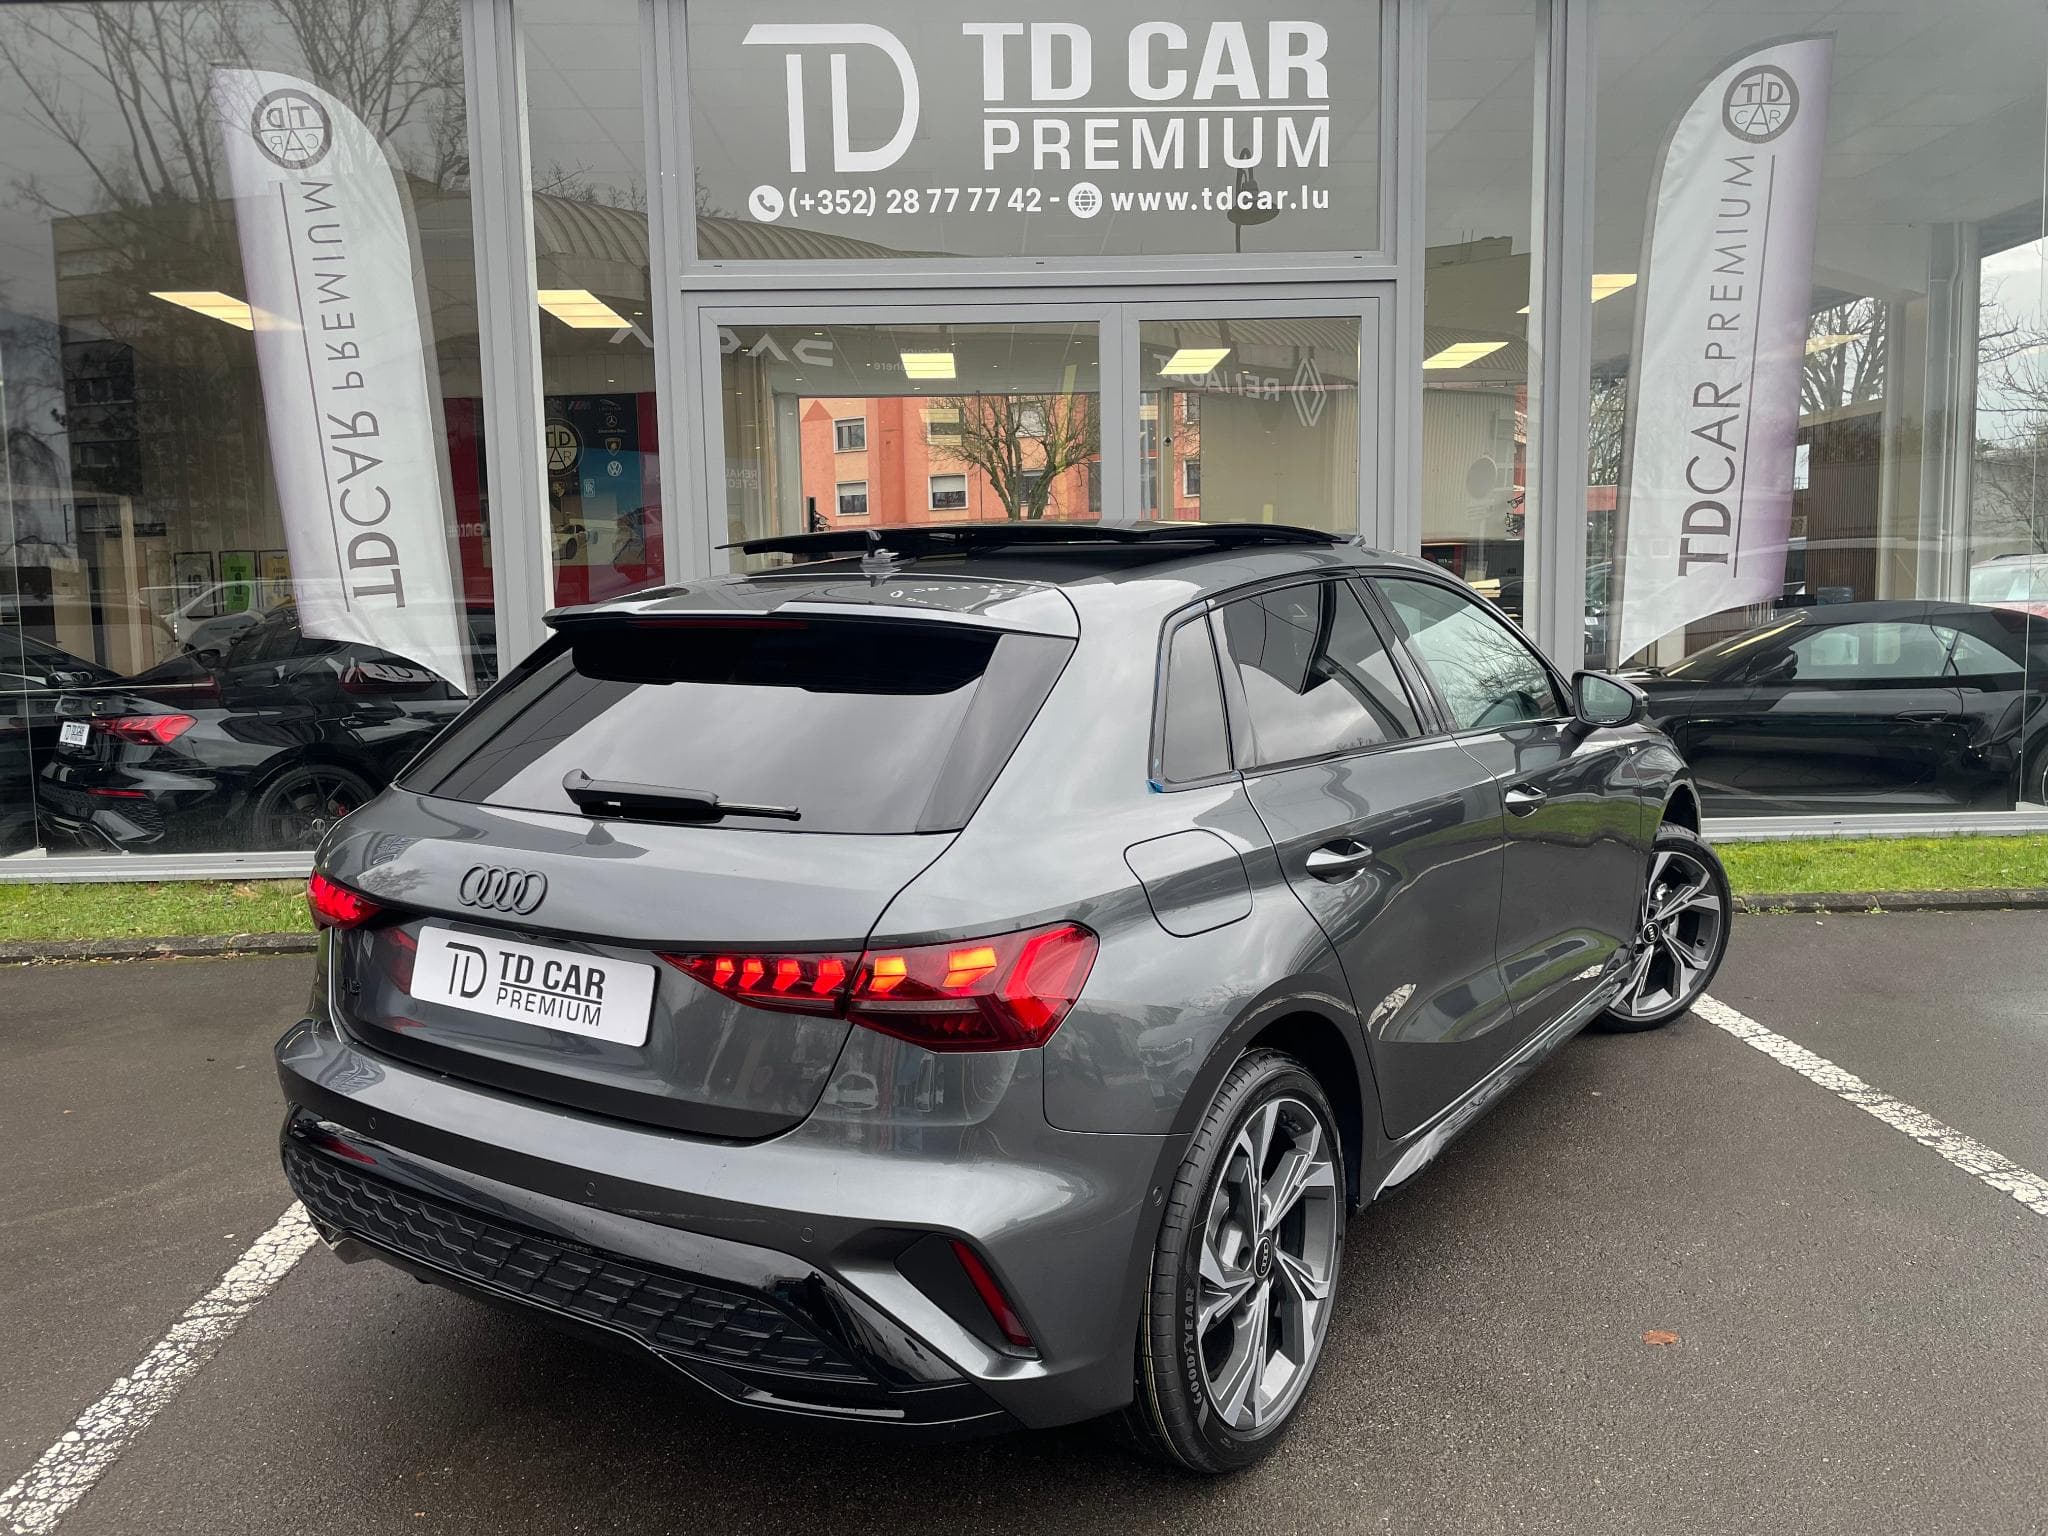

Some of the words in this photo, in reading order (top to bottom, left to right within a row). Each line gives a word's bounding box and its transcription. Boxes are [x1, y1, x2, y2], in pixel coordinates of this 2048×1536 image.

[962, 21, 1092, 101] TD
[1129, 20, 1330, 100] CAR
[1741, 82, 1784, 103] TD
[983, 116, 1330, 170] PREMIUM
[789, 187, 876, 217] (+352)
[886, 188, 920, 214] 28
[926, 188, 960, 213] 77
[967, 187, 1001, 212] 77
[1007, 187, 1042, 212] 42
[1110, 185, 1329, 211] www.tdcar.lu
[1705, 155, 1756, 360] PREMIUM
[499, 951, 535, 985] TD
[543, 960, 606, 1000] CAR
[496, 988, 601, 1027] PREMIUM
[1183, 1287, 1203, 1405] GOODYEAR
